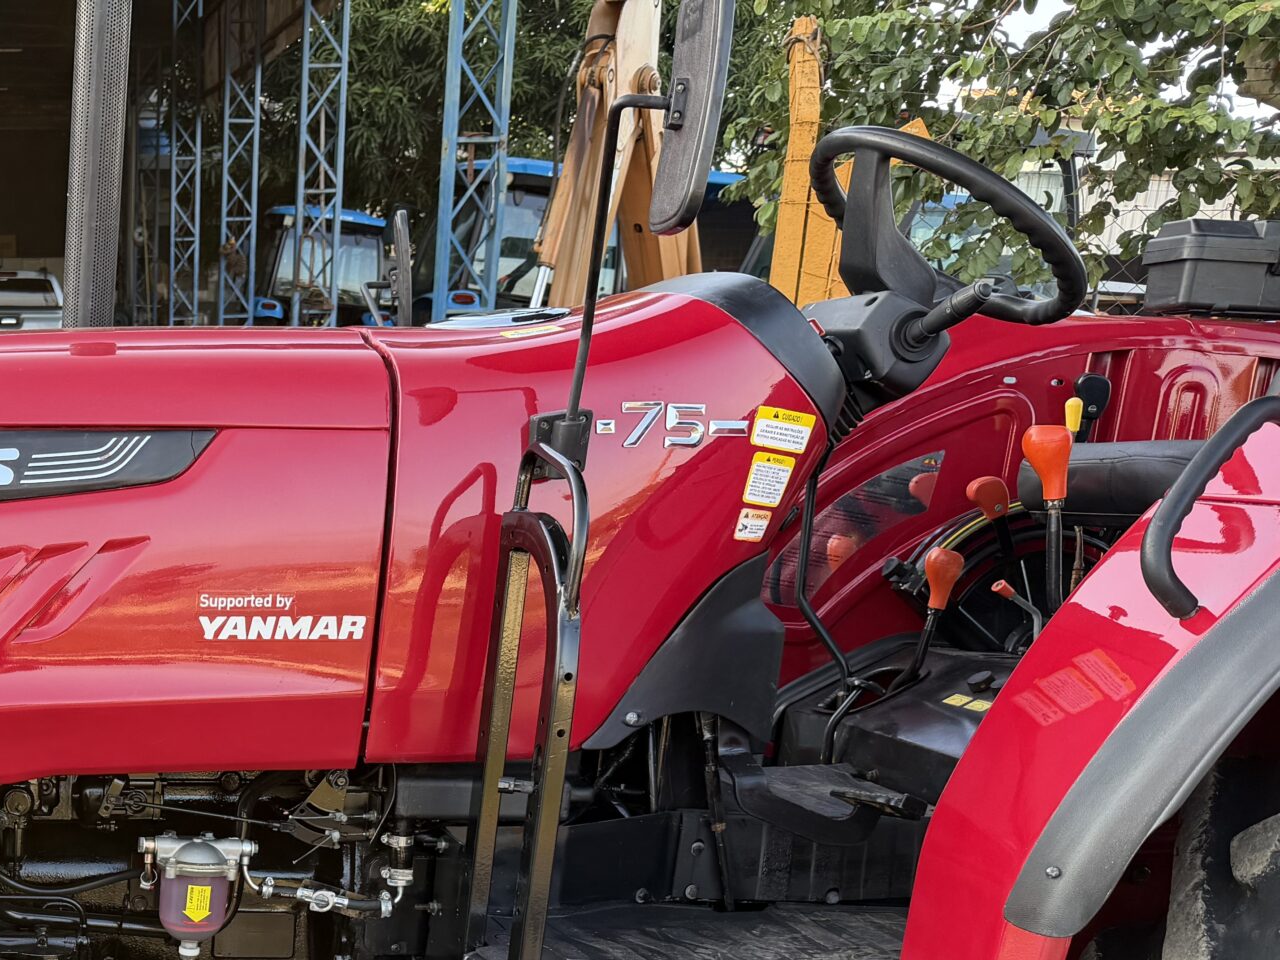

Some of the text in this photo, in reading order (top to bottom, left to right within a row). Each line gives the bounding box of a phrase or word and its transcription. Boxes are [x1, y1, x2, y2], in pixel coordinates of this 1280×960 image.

[199, 594, 293, 610] Supported by
[198, 615, 367, 640] YANMAR
